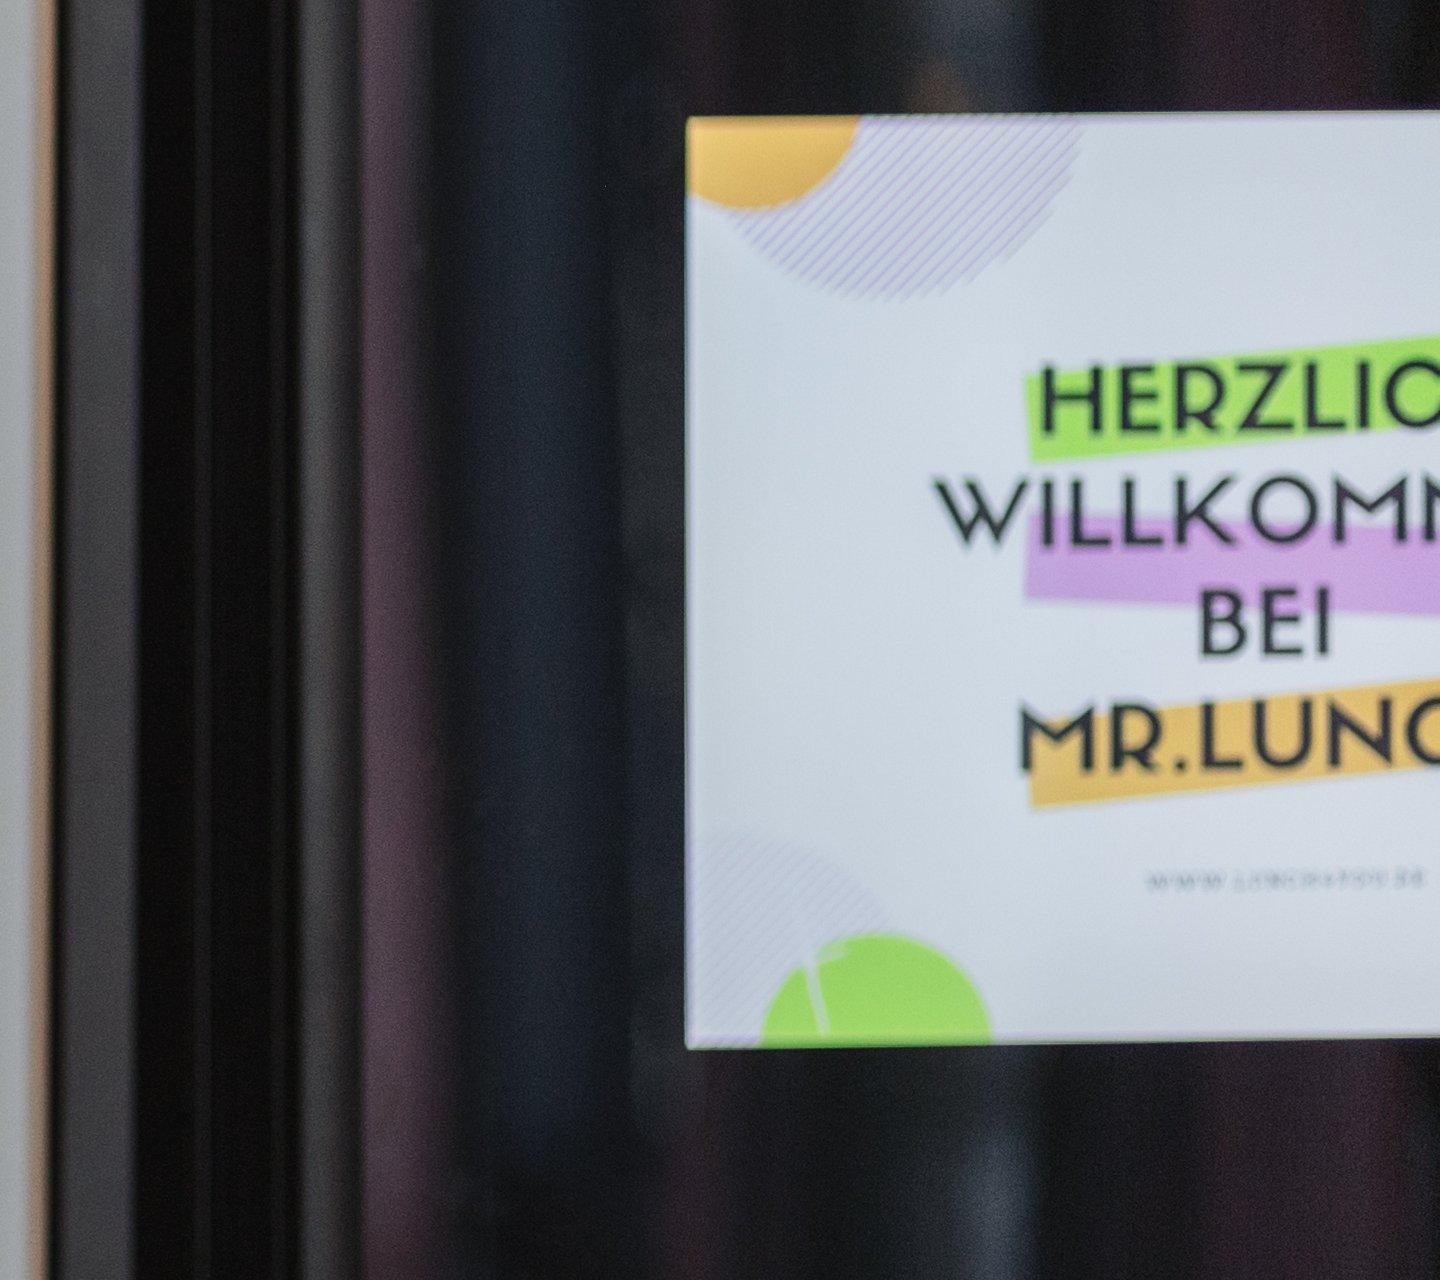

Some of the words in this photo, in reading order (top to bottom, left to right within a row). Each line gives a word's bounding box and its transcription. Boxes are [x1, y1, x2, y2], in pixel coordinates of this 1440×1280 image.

[1041, 357, 1440, 434] HERZLIC
[934, 475, 1440, 547] WILLKOM
[1198, 586, 1330, 657] BEI
